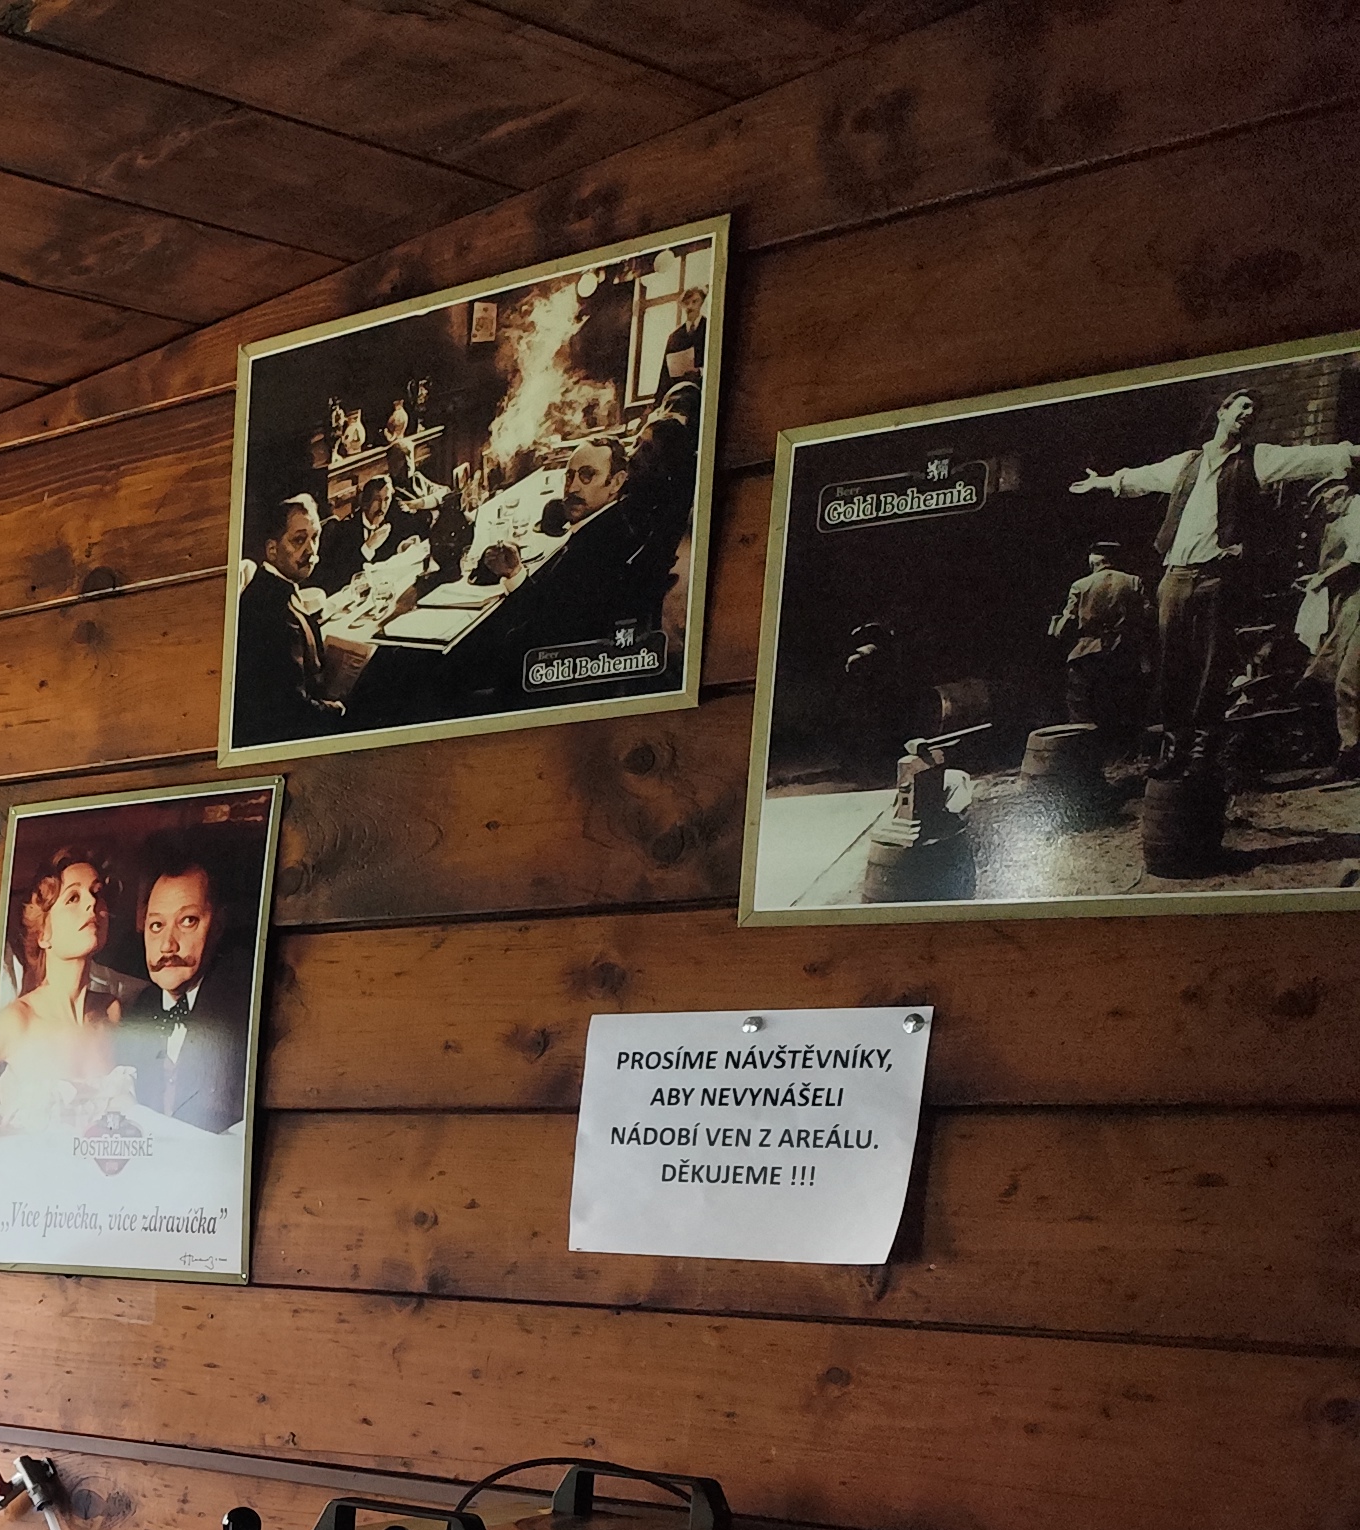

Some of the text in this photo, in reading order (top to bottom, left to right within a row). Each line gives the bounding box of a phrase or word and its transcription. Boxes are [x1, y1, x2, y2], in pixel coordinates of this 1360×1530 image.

[825, 480, 977, 525] Gold Bohemia
[528, 648, 659, 684] Gold Bohemia
[616, 1043, 894, 1074] PROSÍME NÁVŠTĚVNÍKY,
[650, 1082, 845, 1107] ABY NEVYNÁŠELI
[610, 1122, 880, 1151] NÁDOBÍ VEN Z AREÁLU.
[661, 1158, 816, 1187] DĚKUJEME !!!
[43, 1203, 103, 1238] pivečka,
[108, 1206, 138, 1232] více
